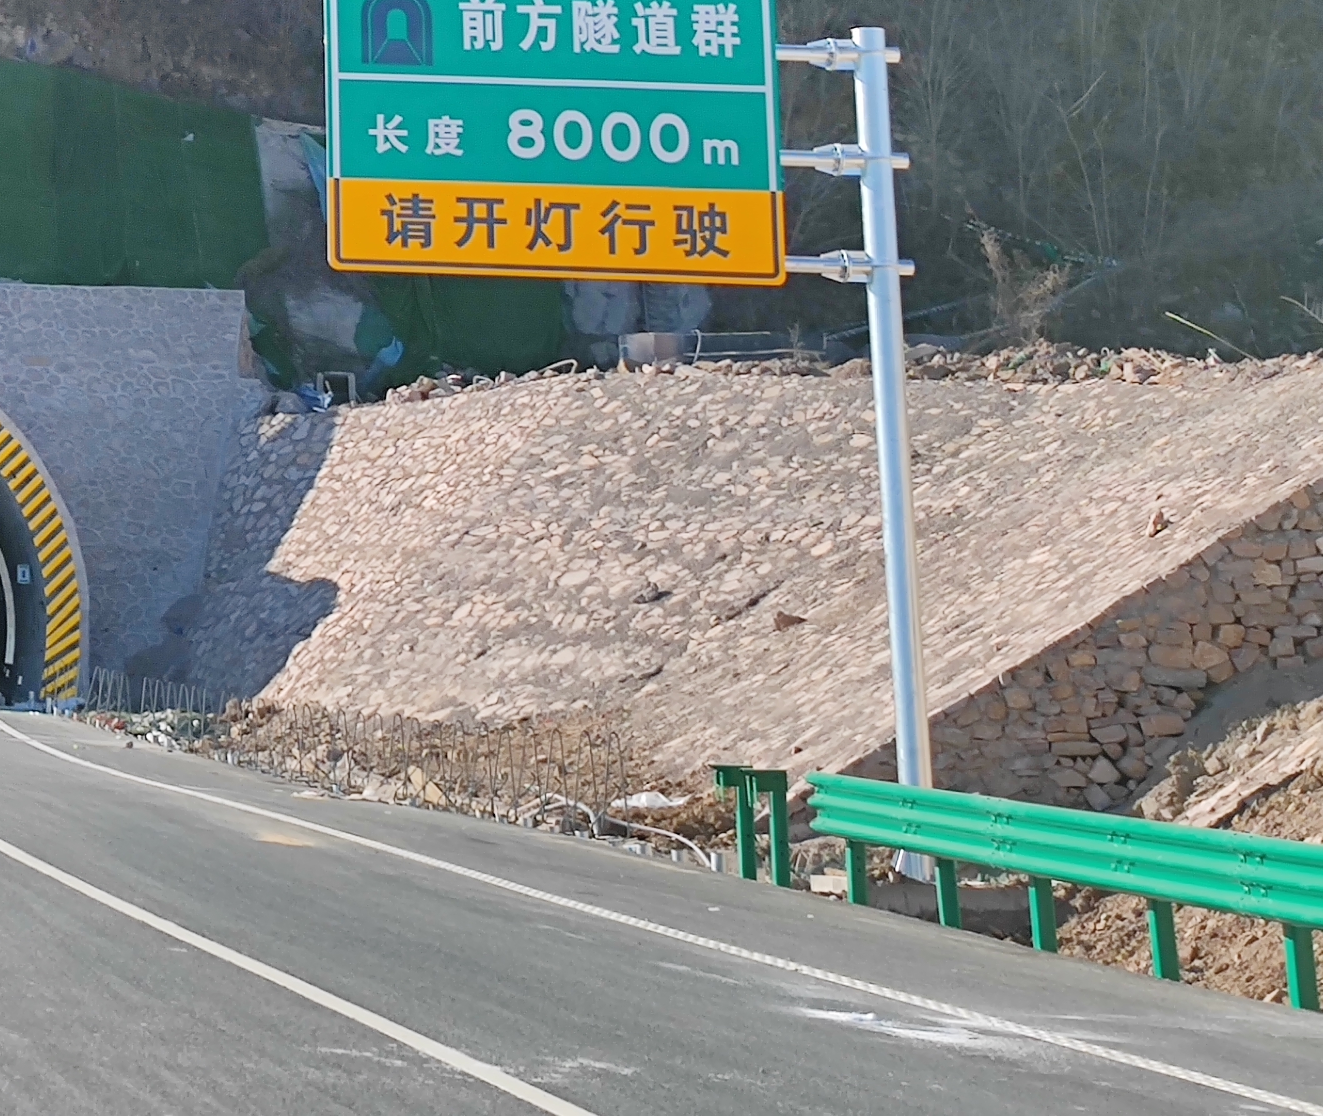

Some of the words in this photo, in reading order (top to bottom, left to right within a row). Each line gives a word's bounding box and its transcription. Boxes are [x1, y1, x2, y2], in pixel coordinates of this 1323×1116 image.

[369, 114, 463, 156] 长度
[508, 109, 739, 165] 8000m
[380, 192, 731, 259] 请开灯行驶
